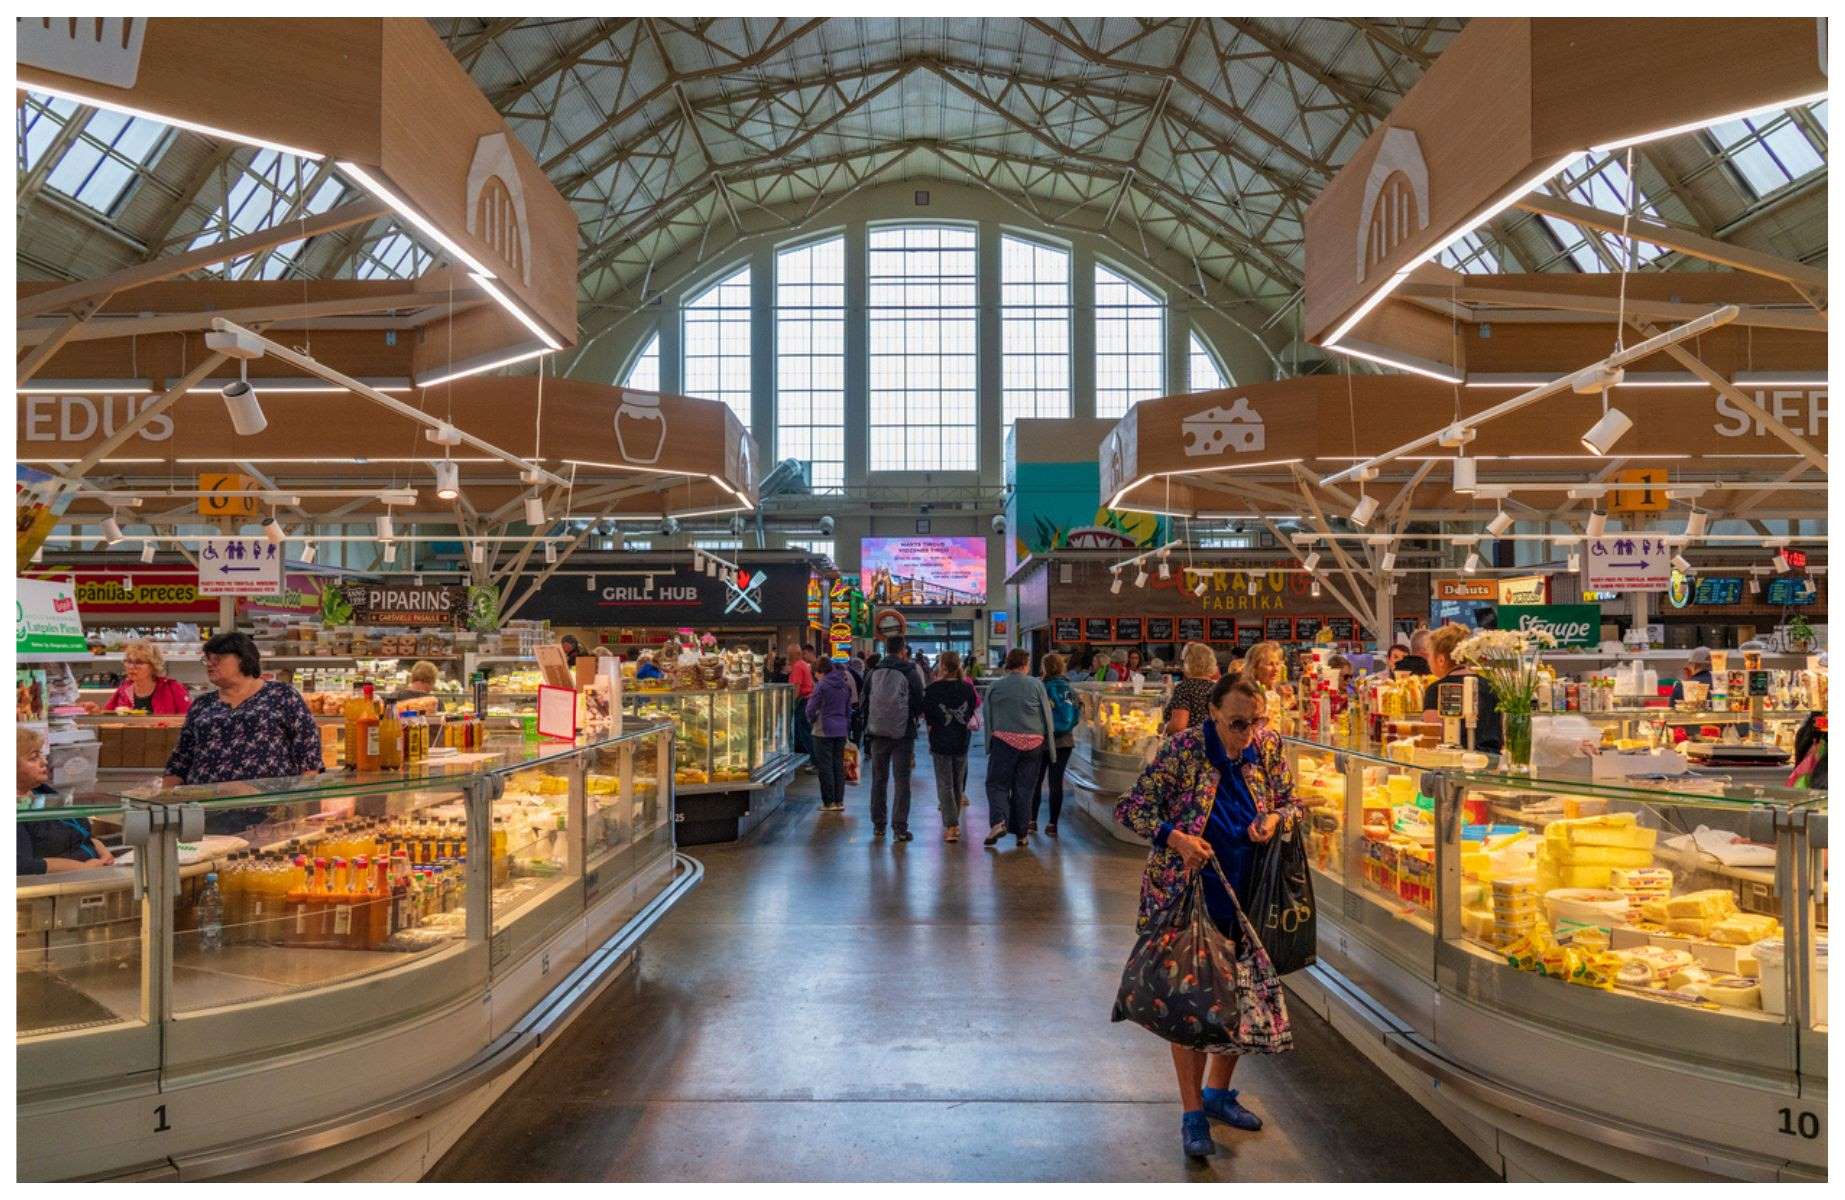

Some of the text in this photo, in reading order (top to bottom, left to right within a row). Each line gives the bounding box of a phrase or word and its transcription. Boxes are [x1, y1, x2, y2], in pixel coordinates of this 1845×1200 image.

[209, 476, 229, 510] 6
[1641, 474, 1657, 505] 1
[140, 587, 194, 601] preces
[370, 587, 450, 612] PIPARIŅŠ
[602, 586, 698, 601] GRILL HUB
[1203, 596, 1285, 610] FABRIKA
[1519, 614, 1591, 645] Straupe
[153, 1104, 171, 1133] 1
[1778, 1107, 1820, 1140] 10
